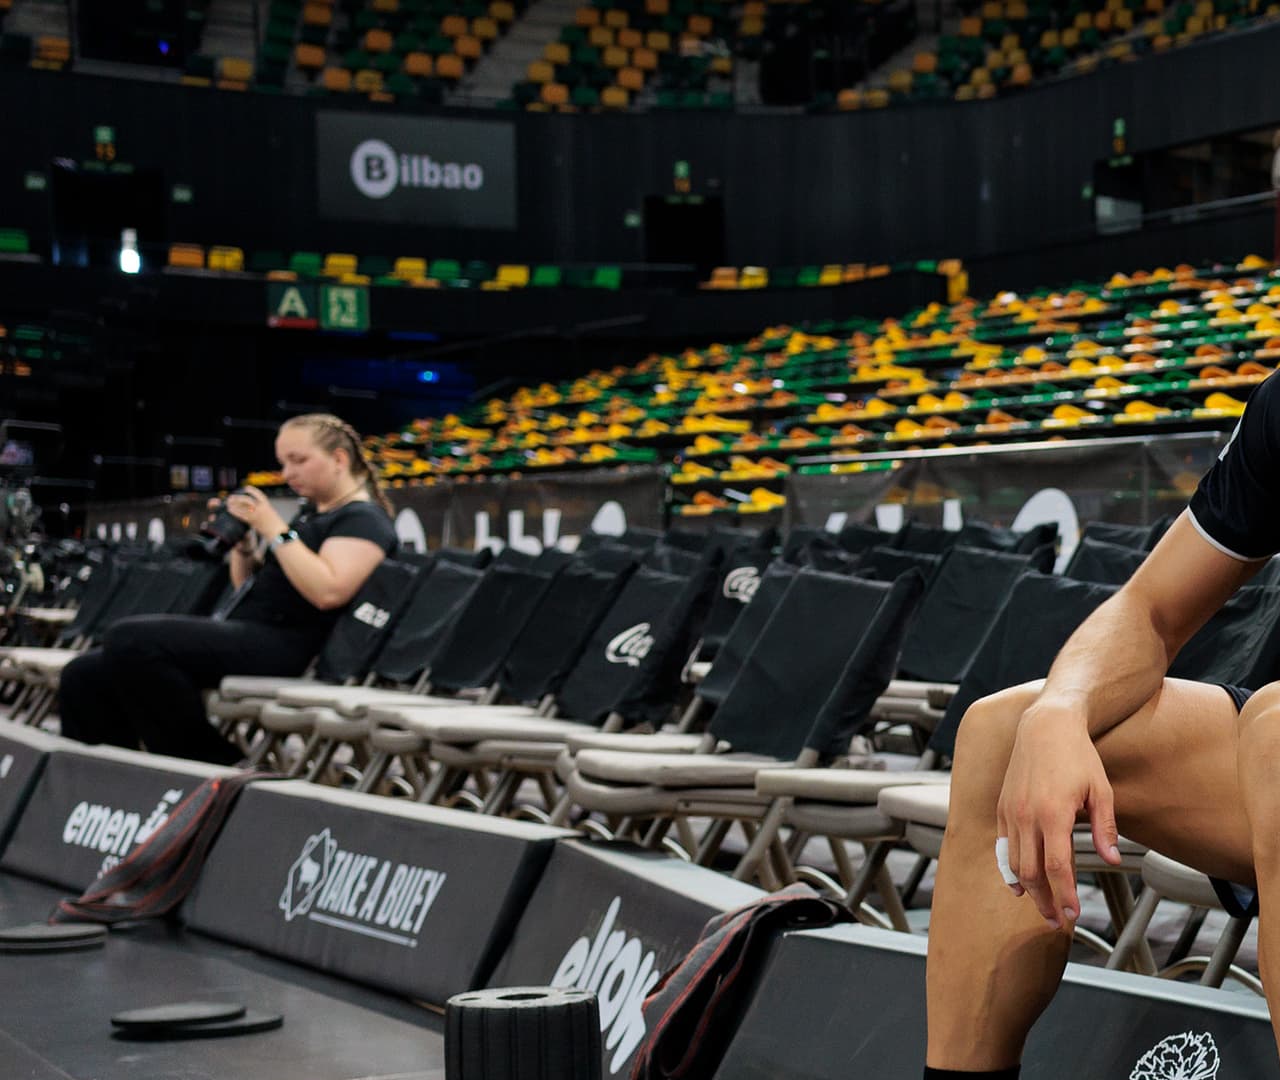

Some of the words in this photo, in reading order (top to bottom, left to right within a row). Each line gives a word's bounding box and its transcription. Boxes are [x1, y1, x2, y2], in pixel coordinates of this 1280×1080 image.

[352, 139, 483, 198] Bilbao
[316, 850, 378, 917] TAKE
[358, 860, 392, 922] A
[374, 863, 447, 934] BUEY
